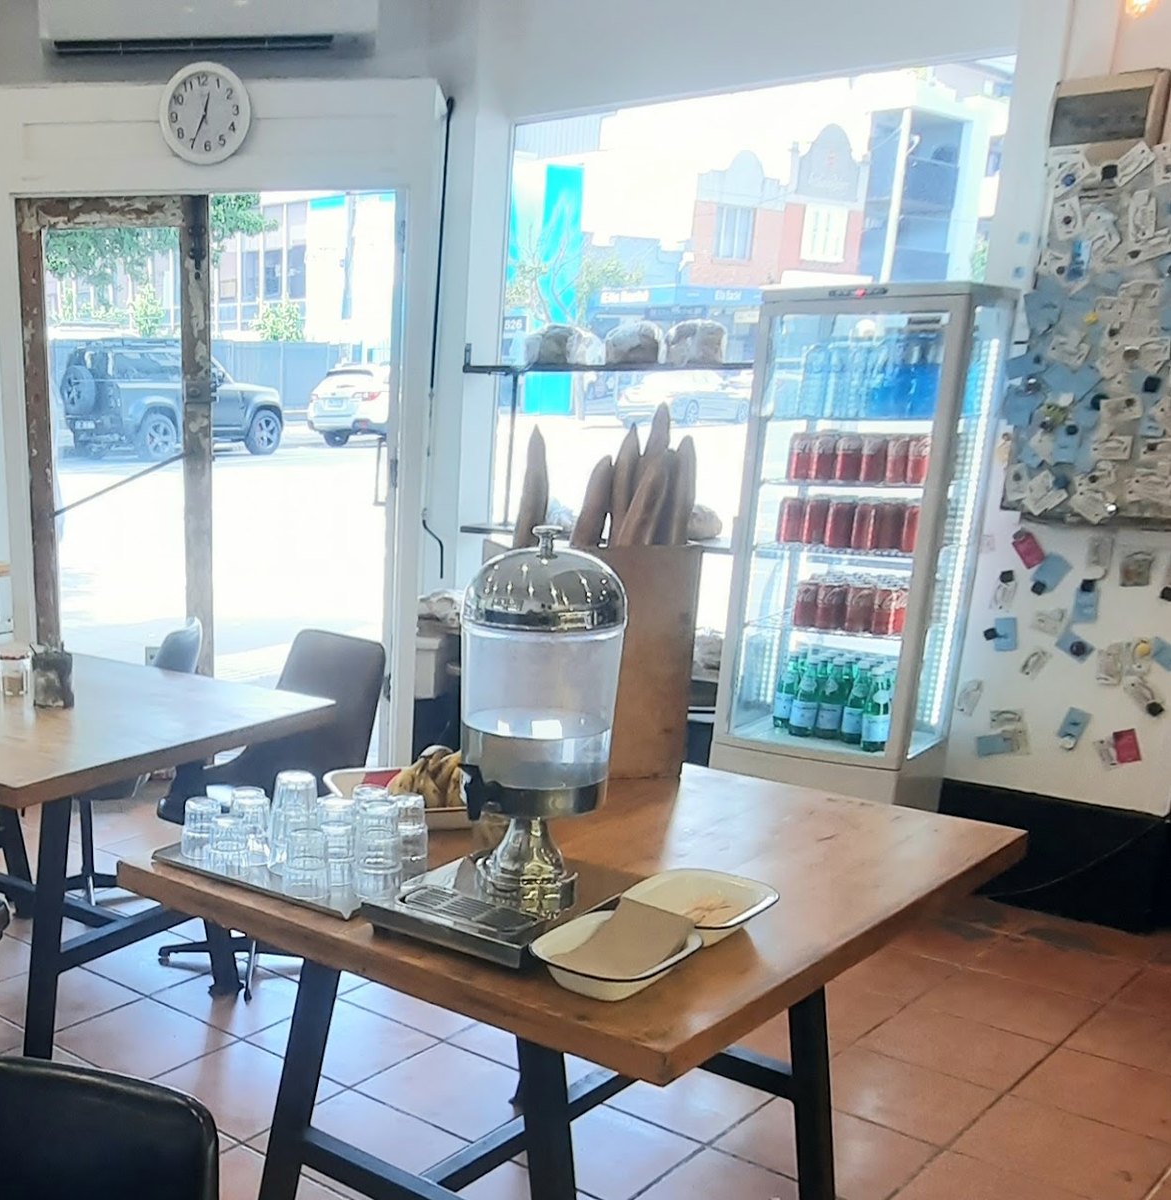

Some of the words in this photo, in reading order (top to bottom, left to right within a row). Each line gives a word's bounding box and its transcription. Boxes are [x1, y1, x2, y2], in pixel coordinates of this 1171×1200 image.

[197, 73, 208, 86] 12
[216, 77, 220, 88] 1
[183, 80, 193, 92] 11
[173, 94, 184, 105] 10
[226, 87, 233, 100] 2
[232, 104, 239, 116] 3
[170, 112, 178, 123] 9
[177, 127, 184, 139] 8
[228, 121, 235, 133] 4
[189, 138, 196, 150] 7
[204, 140, 211, 152] 6
[218, 134, 226, 147] 5
[504, 319, 523, 330] 526
